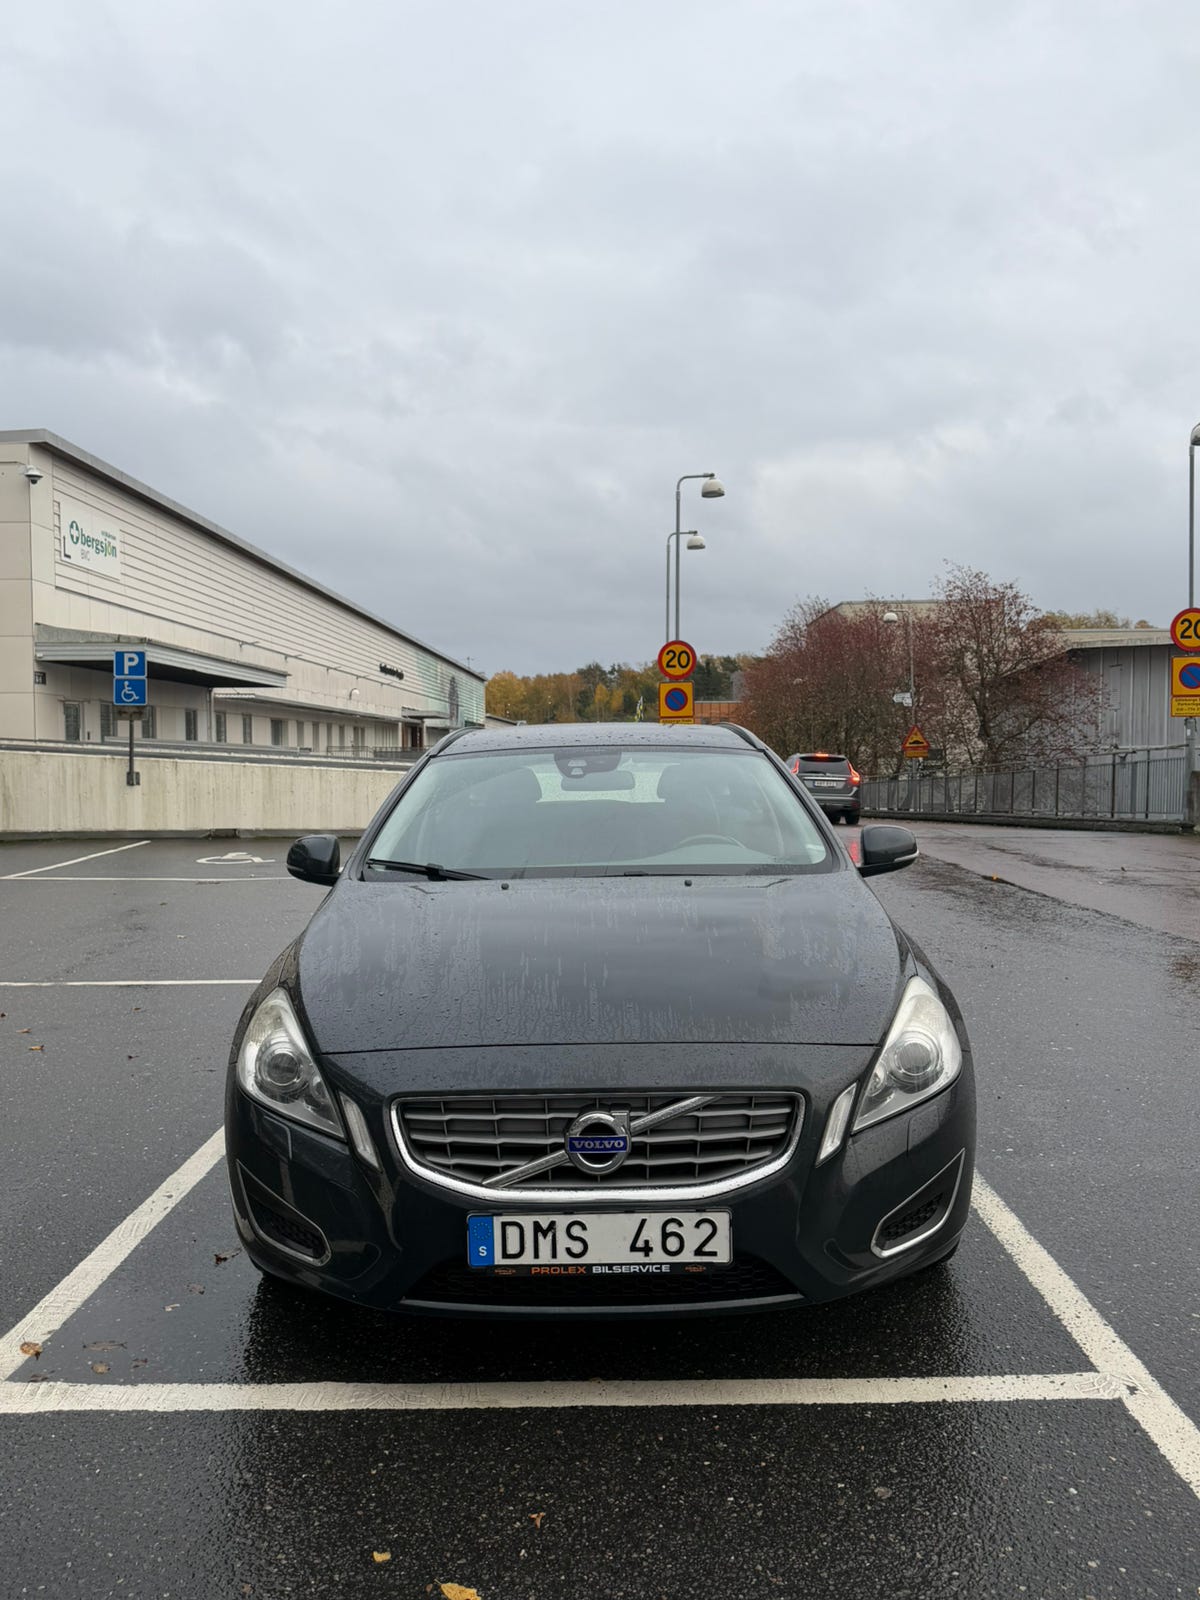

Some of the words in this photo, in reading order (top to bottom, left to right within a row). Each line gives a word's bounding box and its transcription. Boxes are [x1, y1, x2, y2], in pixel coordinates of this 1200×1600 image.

[80, 527, 117, 558] bergsjön
[123, 653, 139, 675] P
[665, 649, 691, 669] 20
[571, 1140, 625, 1149] VOLVO
[501, 1220, 589, 1260] DMS
[629, 1218, 718, 1258] 462
[478, 1246, 488, 1257] S
[531, 1266, 587, 1275] PROLEX
[592, 1264, 671, 1274] BILSERVICE
